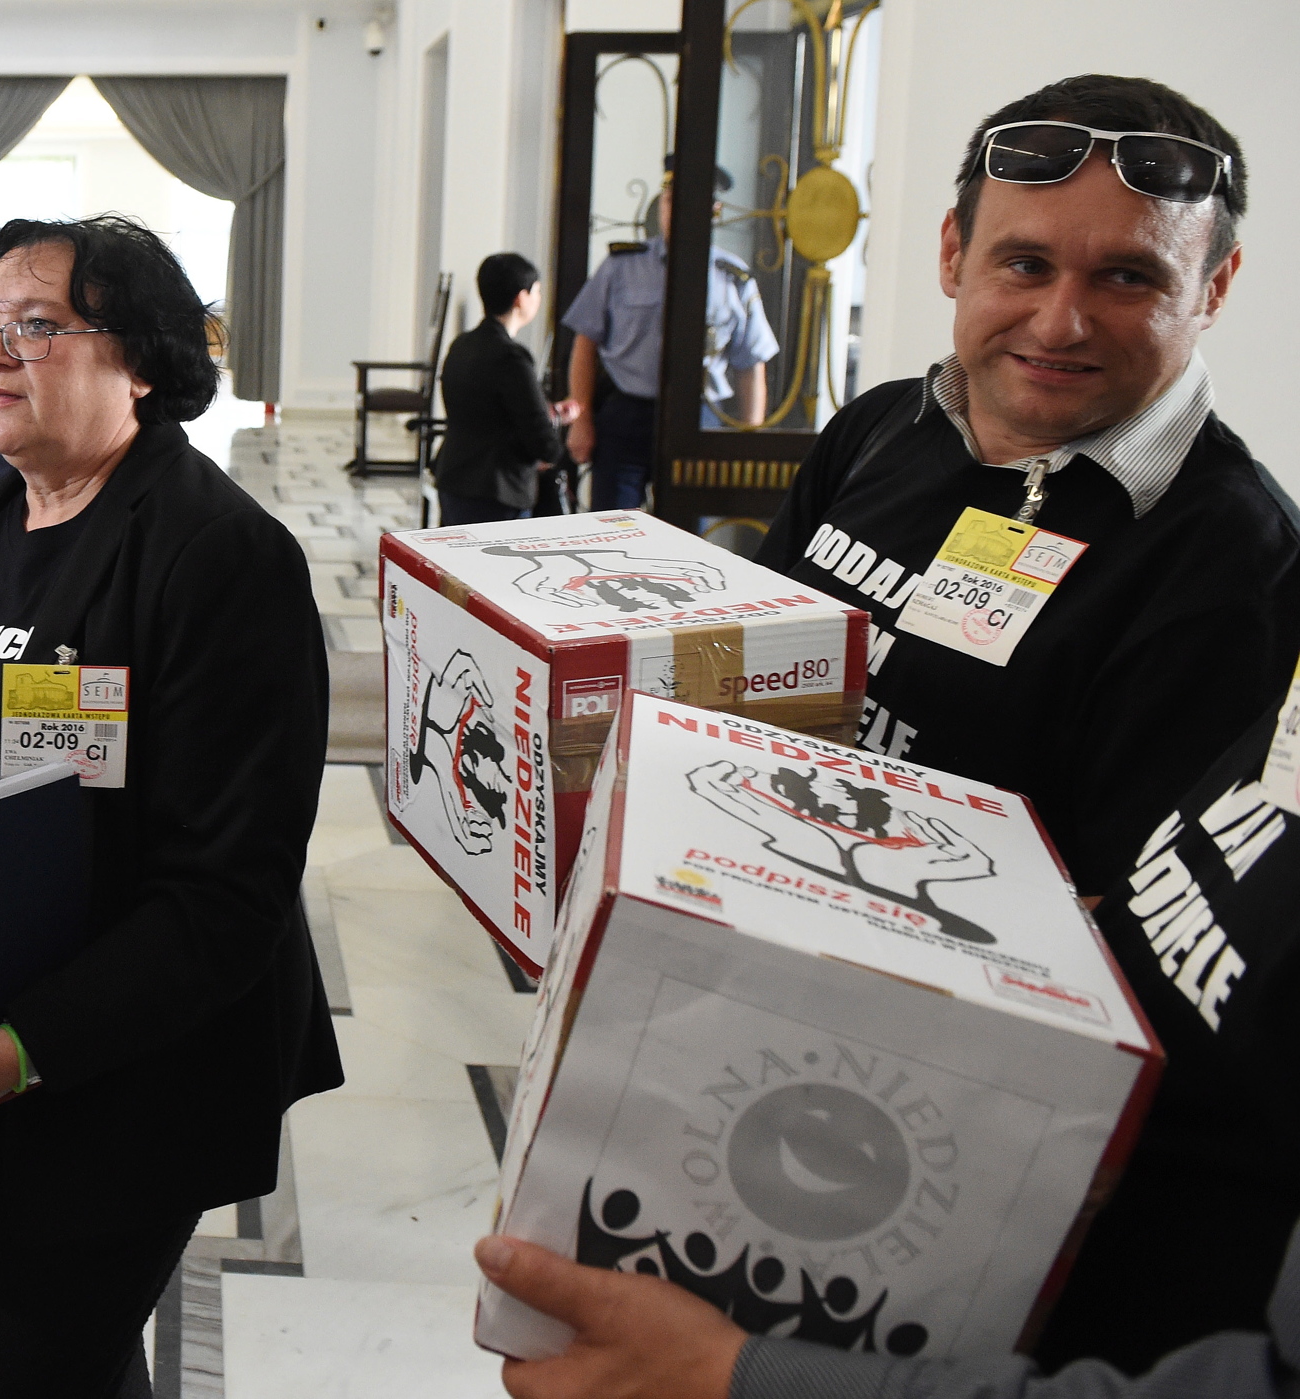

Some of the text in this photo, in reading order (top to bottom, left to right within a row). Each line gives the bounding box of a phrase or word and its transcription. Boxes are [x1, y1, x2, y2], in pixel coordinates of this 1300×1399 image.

[933, 577, 991, 610] 02-09
[962, 573, 1003, 593] Rok 2016
[545, 594, 818, 634] NIEDZIELE
[409, 610, 421, 710] podpisz
[717, 658, 829, 701] speed 80
[84, 685, 123, 700] SEJM
[571, 694, 615, 717] POL
[11, 711, 60, 719] JEDNORAZOWA
[41, 722, 85, 732] Rok 2016
[20, 731, 79, 750] 02-09
[722, 718, 927, 779] ODZYSKAJMY
[657, 710, 1009, 819] NIEDZIELE
[514, 666, 532, 939] NIEDZIELE
[532, 732, 548, 897] ODZYSKAJMY
[684, 848, 852, 904] podpisz
[866, 899, 928, 928] się
